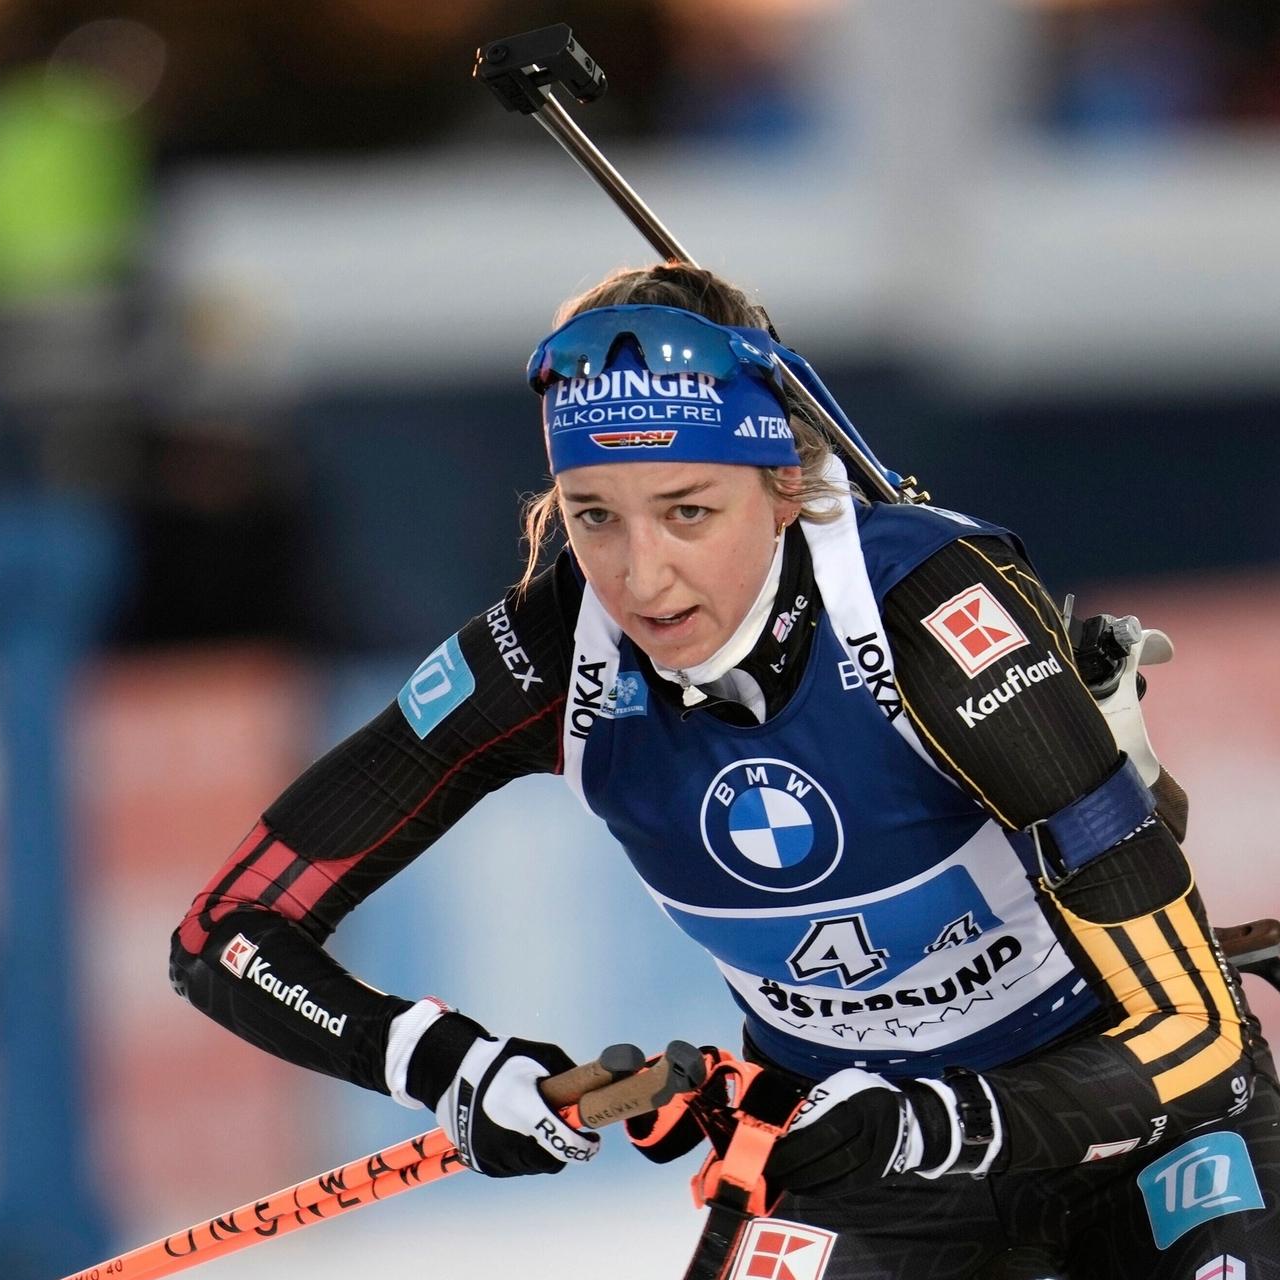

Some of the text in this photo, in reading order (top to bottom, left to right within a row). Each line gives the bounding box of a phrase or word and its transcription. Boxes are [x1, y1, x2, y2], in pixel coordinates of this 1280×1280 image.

[552, 405, 721, 428] ALKOHOLFREI
[554, 368, 723, 408] ERDINGER
[846, 631, 904, 722] JOKA
[956, 650, 1062, 729] Kaufland
[714, 765, 813, 808] BMW
[786, 913, 890, 989] 4
[247, 956, 347, 1038] Kaufland
[1154, 1145, 1242, 1212] TQ
[106, 1259, 123, 1275] 40
